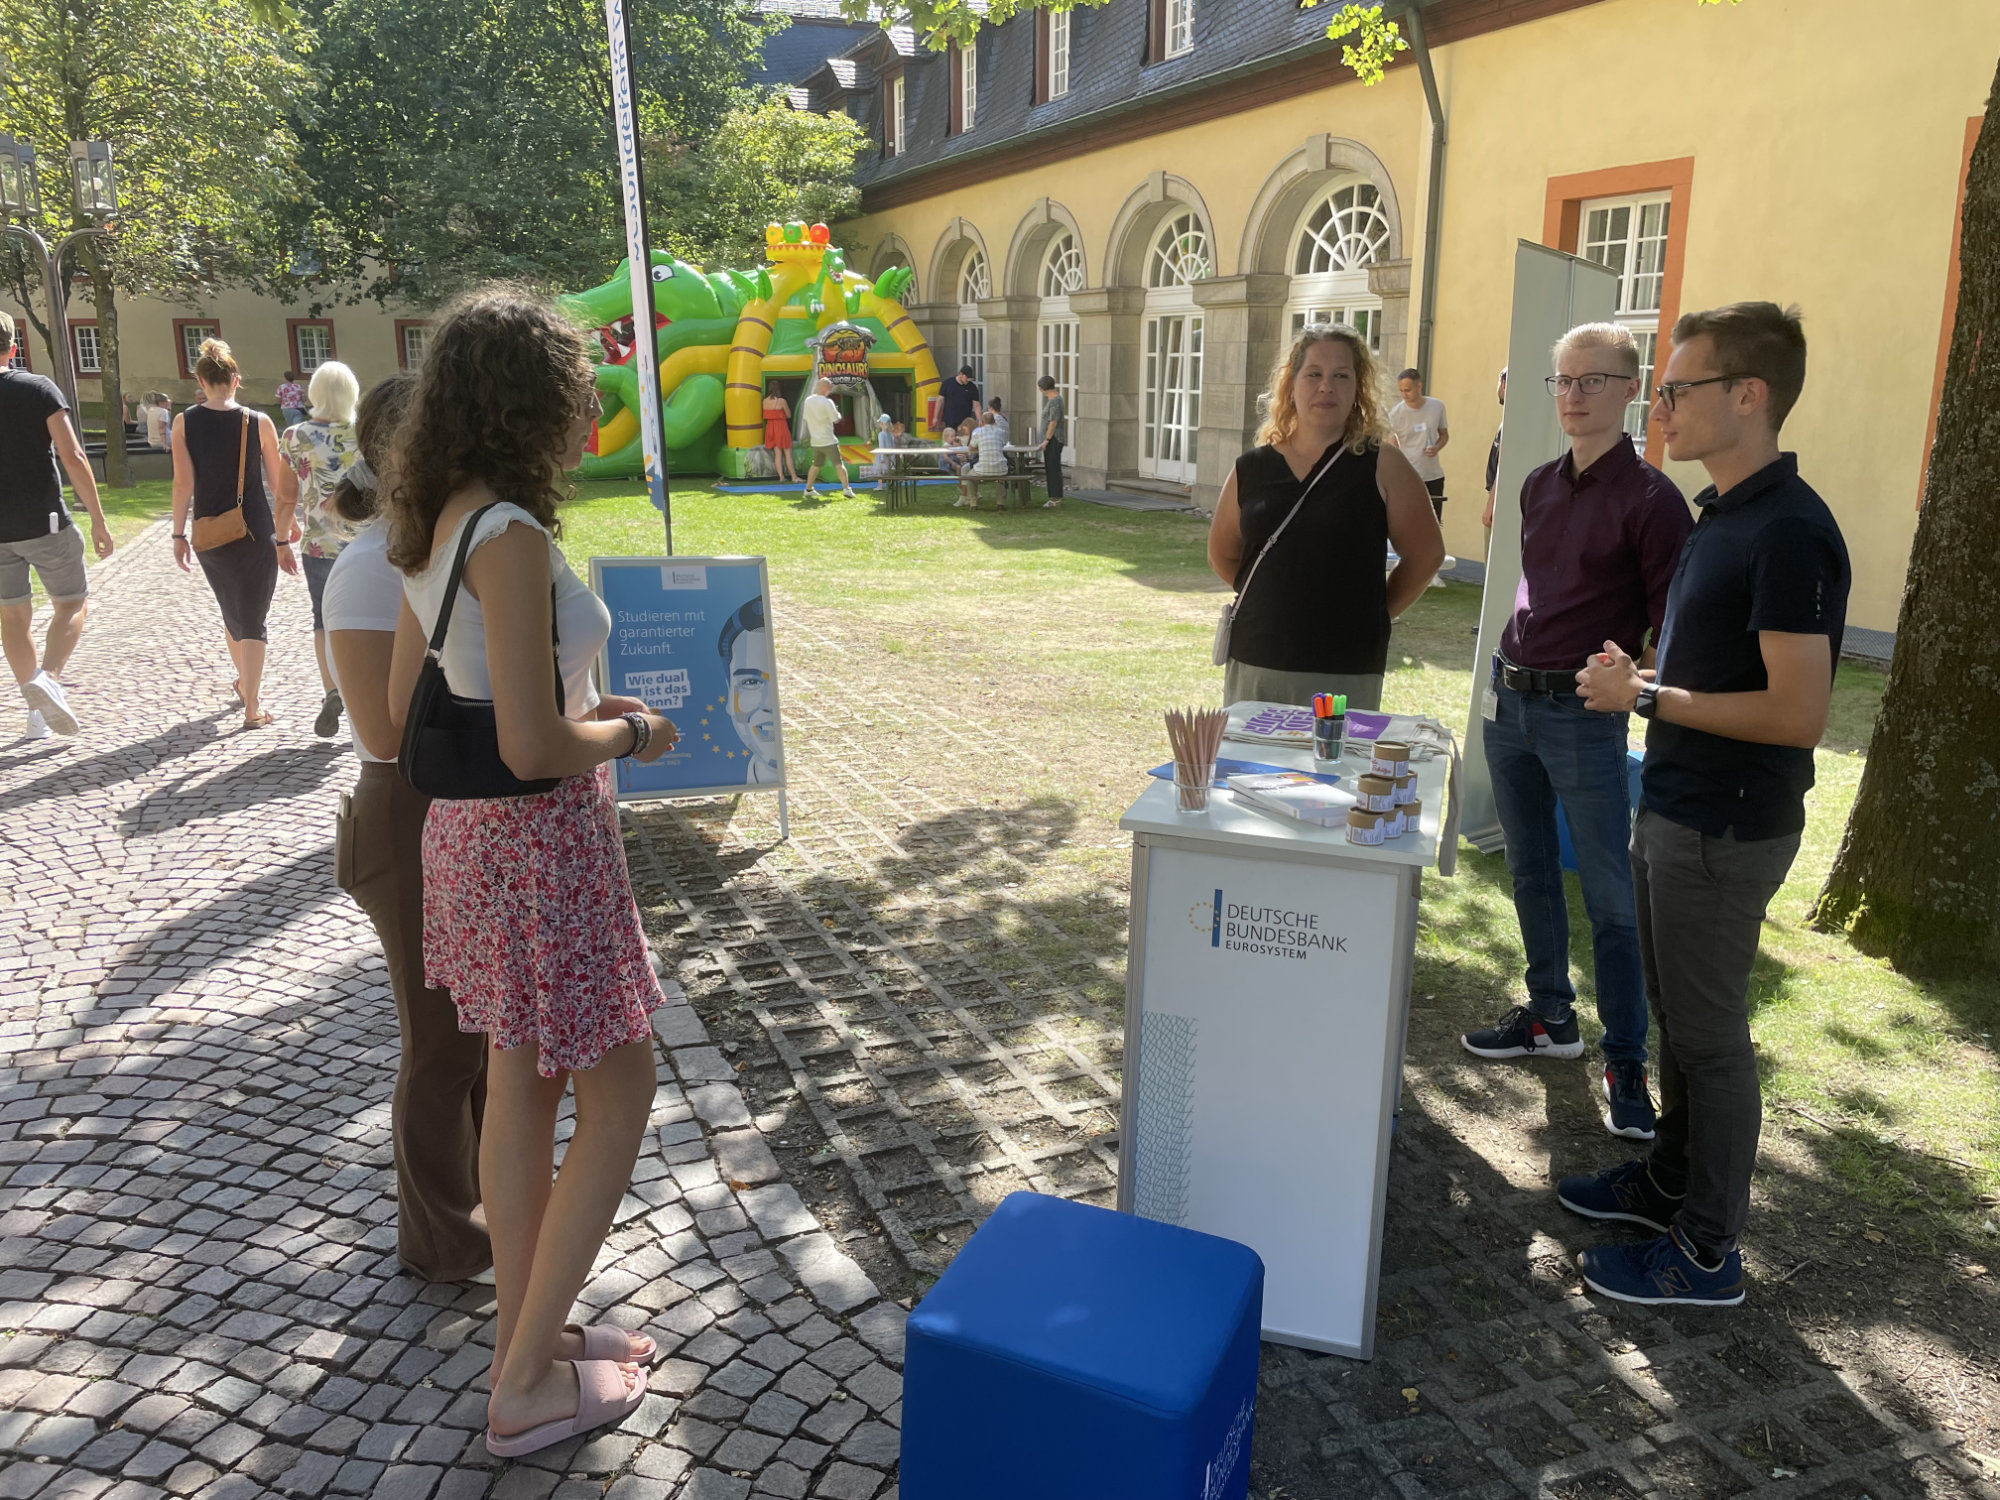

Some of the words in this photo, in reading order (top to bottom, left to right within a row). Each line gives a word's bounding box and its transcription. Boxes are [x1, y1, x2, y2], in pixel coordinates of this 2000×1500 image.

[818, 361, 869, 378] DINOSAURS
[834, 376, 857, 385] WORLD
[617, 609, 680, 623] Studieren
[684, 610, 706, 622] mit
[618, 625, 696, 642] garantierter
[620, 641, 675, 656] Zukunft.
[628, 674, 654, 686] Wie
[655, 671, 685, 684] dual
[644, 685, 662, 696] ist
[664, 684, 688, 695] das
[1227, 903, 1319, 930] DEUTSCHE
[1226, 921, 1348, 953] BUNDESBANK
[1225, 939, 1308, 960] EUROSYSTEM
